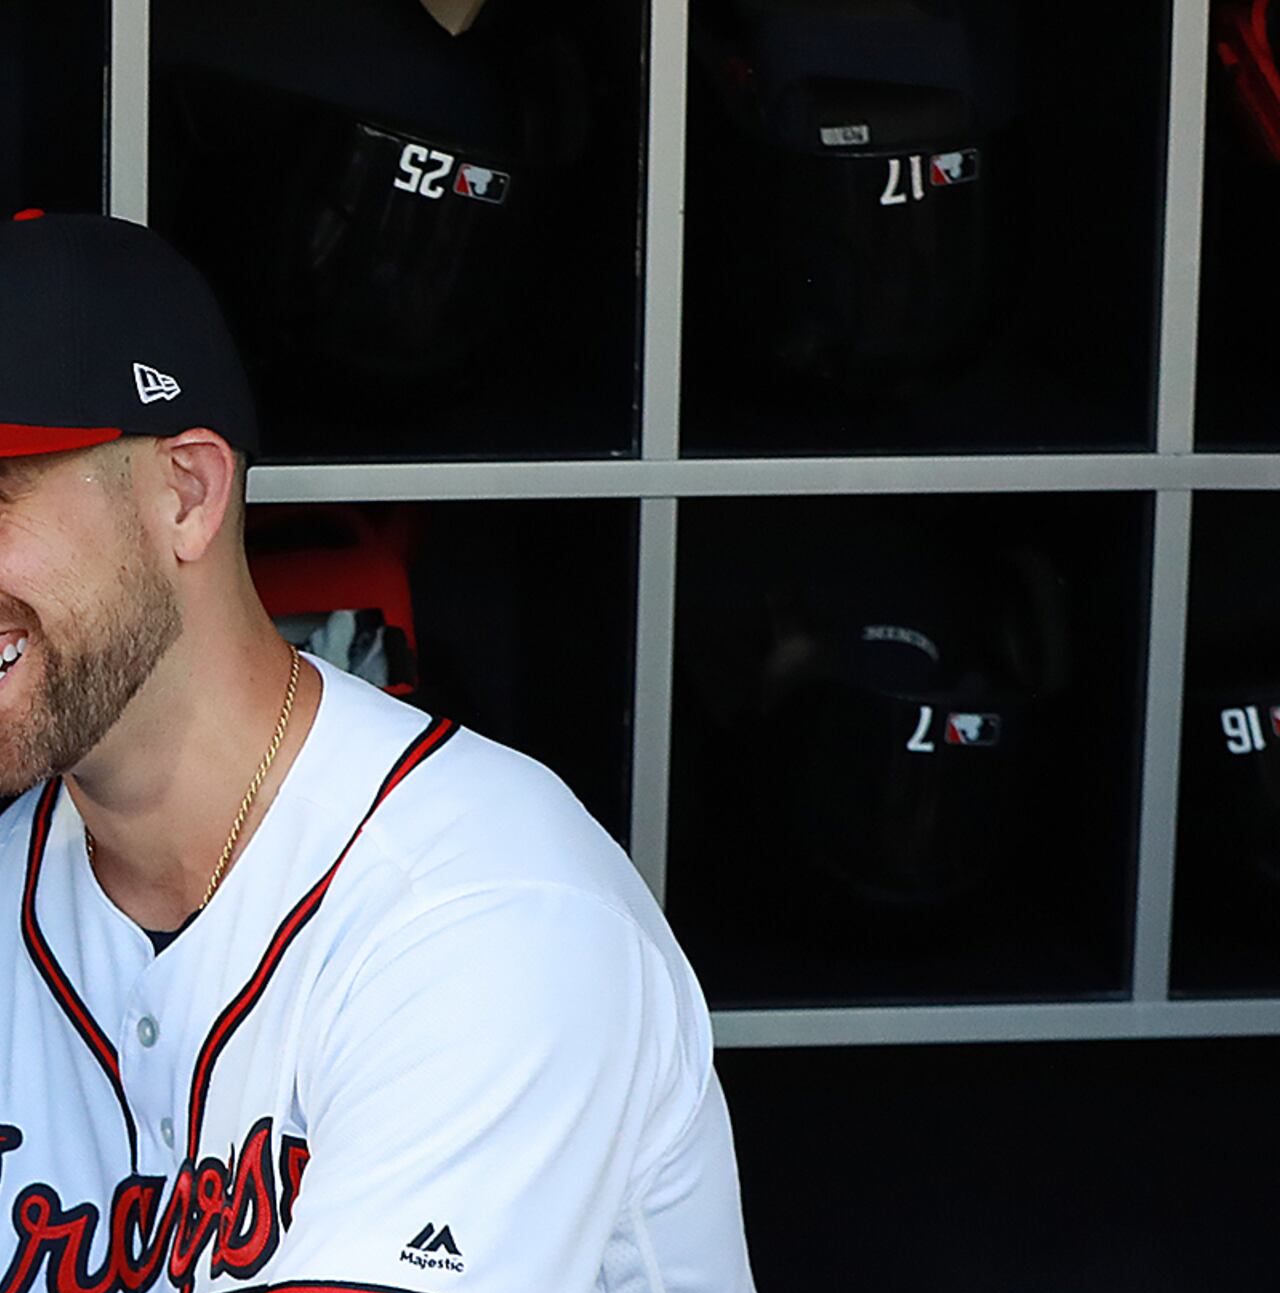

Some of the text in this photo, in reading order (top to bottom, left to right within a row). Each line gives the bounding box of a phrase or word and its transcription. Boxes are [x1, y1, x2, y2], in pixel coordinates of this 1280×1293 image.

[393, 143, 455, 199] 25
[880, 155, 924, 205] 17
[907, 706, 934, 751] 7
[399, 1249, 465, 1273] Majestic
